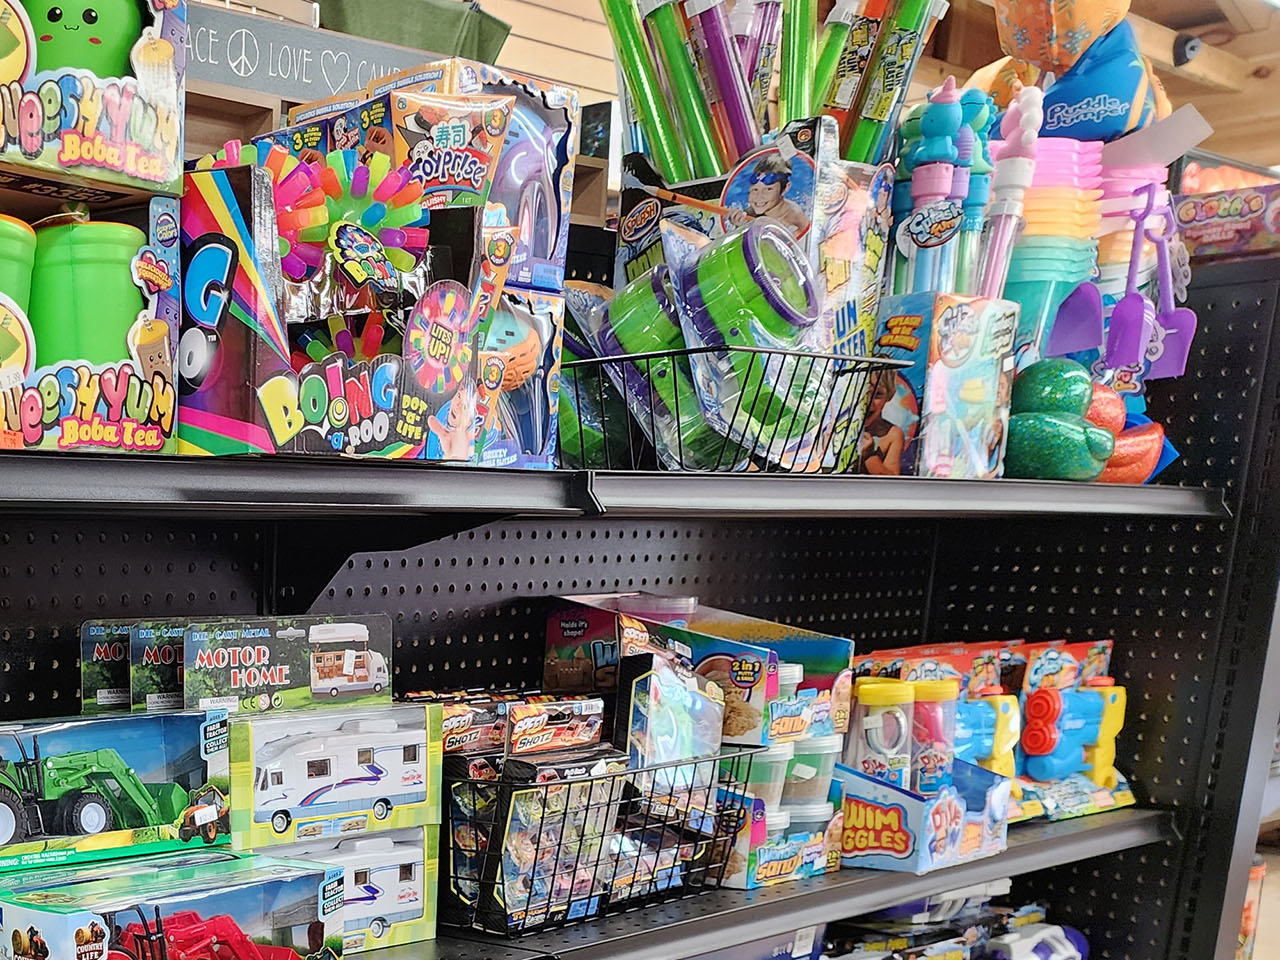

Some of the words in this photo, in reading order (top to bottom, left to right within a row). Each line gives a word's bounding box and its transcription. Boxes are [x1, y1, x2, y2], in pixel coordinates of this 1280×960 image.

[270, 44, 313, 84] LOVE
[1045, 103, 1129, 129] Jumper
[1046, 95, 1120, 122] Puddle
[436, 125, 467, 149] 寿司
[61, 134, 122, 165] Boba
[125, 146, 165, 175] Tea
[430, 321, 453, 341] LITES
[428, 338, 451, 361] UP!
[402, 394, 428, 414] DOT
[60, 416, 120, 445] Boba
[121, 422, 161, 446] Tea
[395, 421, 422, 440] LITE
[242, 628, 271, 638] METAL
[194, 646, 270, 670] MOTOR
[231, 666, 291, 688] HOME
[445, 730, 481, 749] SHOTZ
[77, 942, 104, 954] COUNTRY
